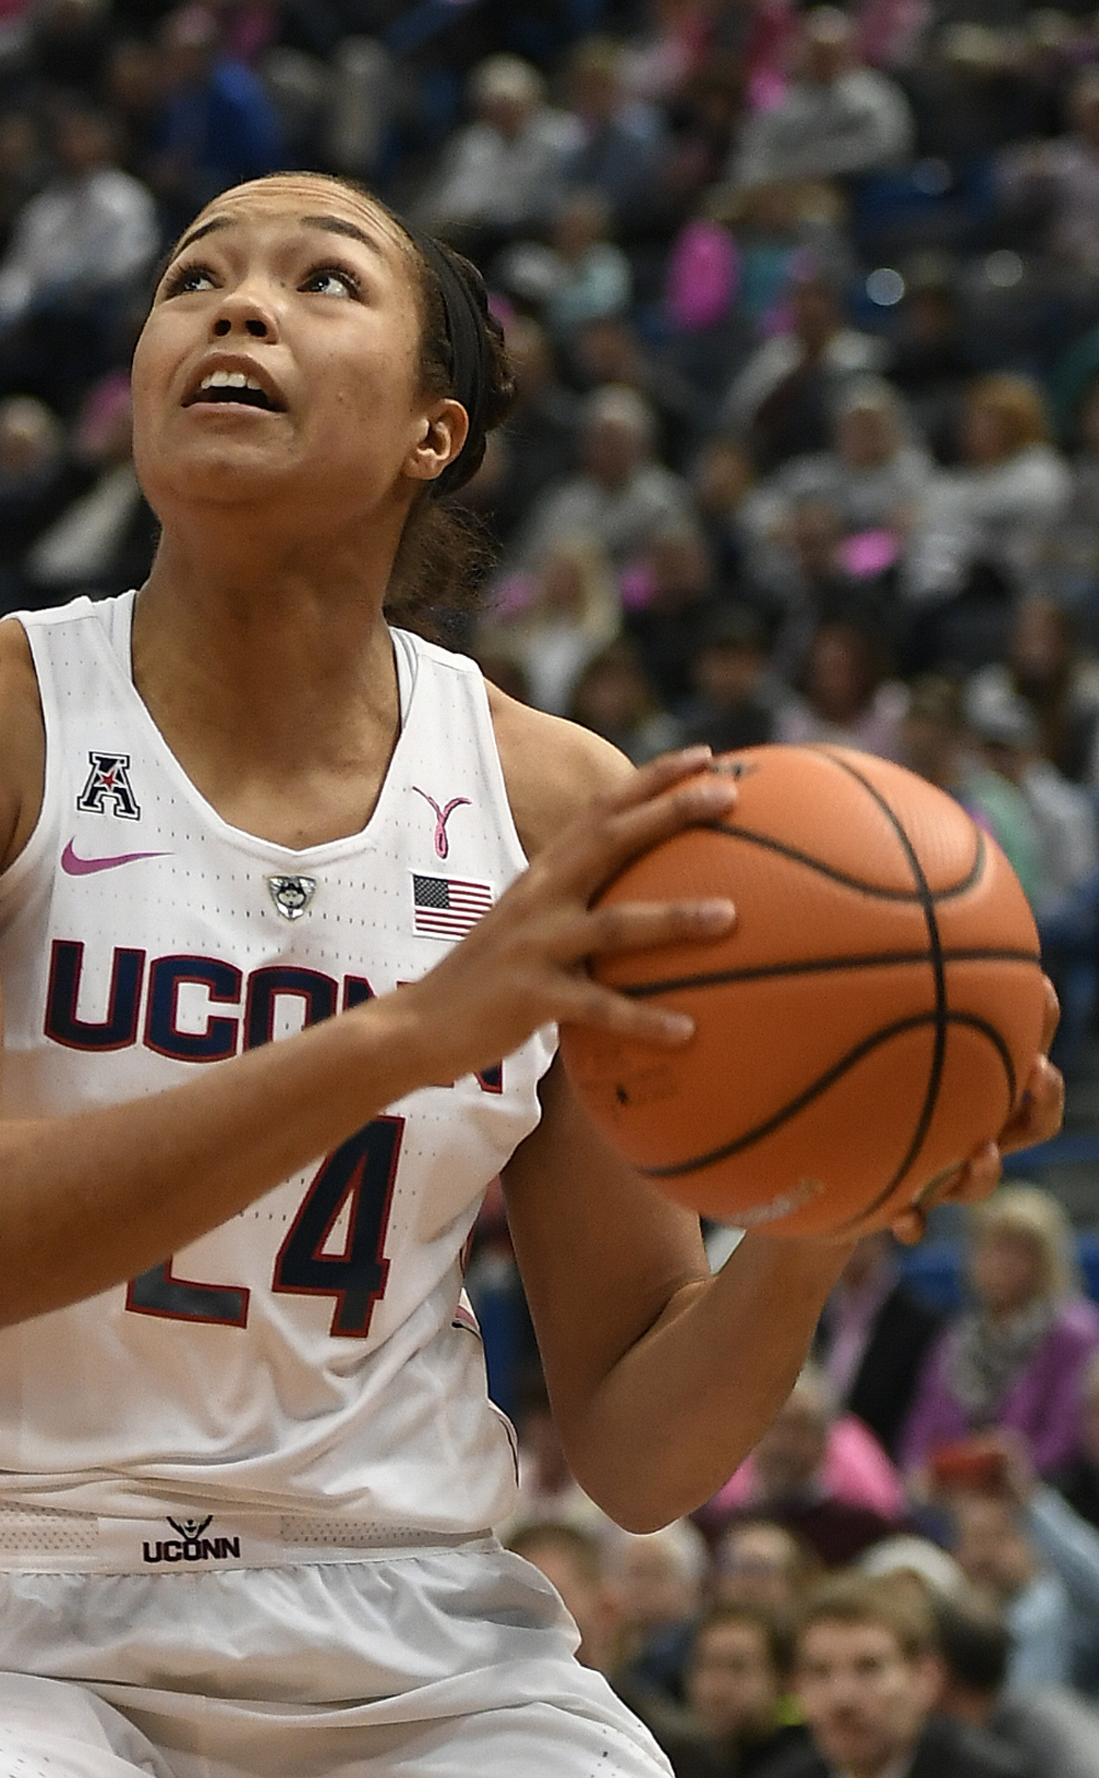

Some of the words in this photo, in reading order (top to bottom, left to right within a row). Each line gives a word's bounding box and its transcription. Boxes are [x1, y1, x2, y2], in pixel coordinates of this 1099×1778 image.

[77, 751, 141, 821] A
[44, 939, 502, 1094] UCO
[125, 1114, 406, 1338] 4
[142, 1537, 241, 1563] UCONN
